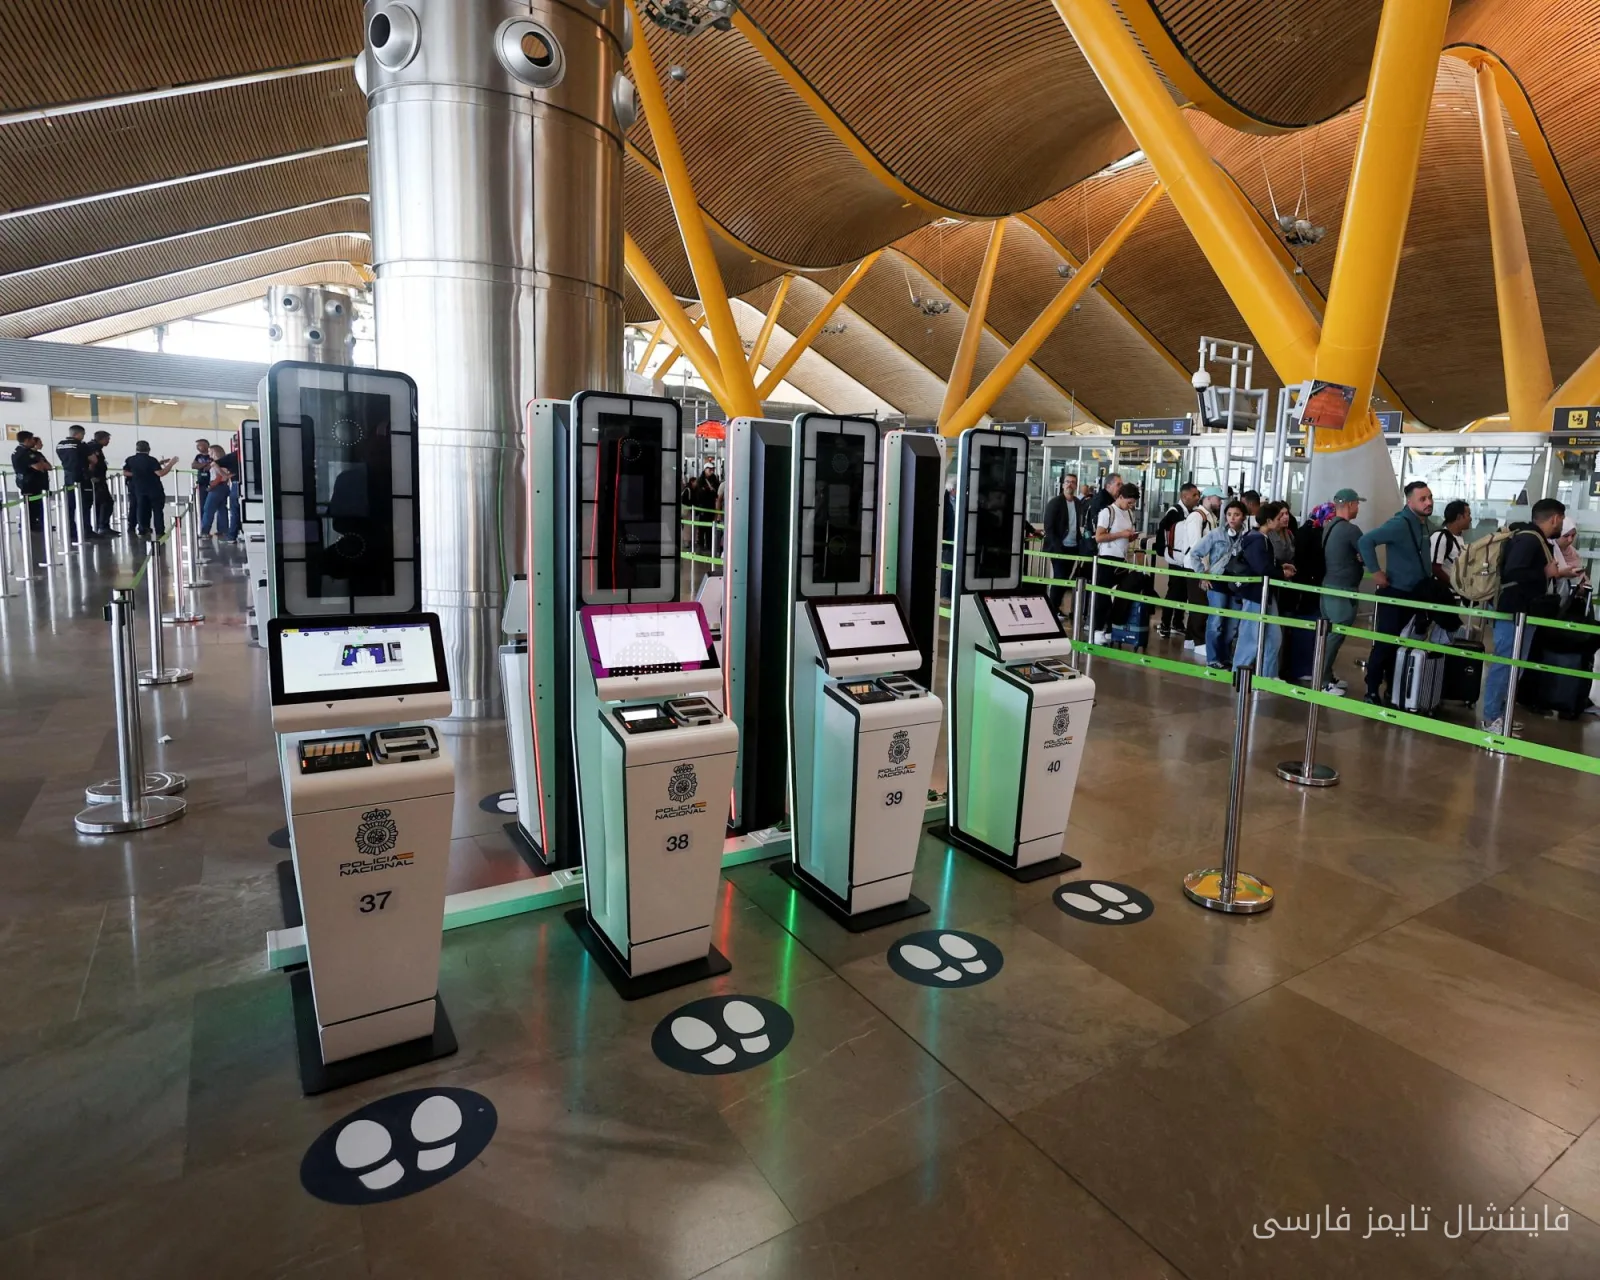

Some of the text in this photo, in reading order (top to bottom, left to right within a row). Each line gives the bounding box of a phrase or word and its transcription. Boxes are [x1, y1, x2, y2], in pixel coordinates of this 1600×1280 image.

[1156, 468, 1167, 478] 10
[878, 766, 907, 774] POLICIA
[1048, 760, 1060, 773] 40
[877, 770, 915, 779] NACIONAL
[885, 790, 903, 806] 39
[654, 808, 706, 820] NACIONAL
[656, 803, 696, 814] POLICIA
[666, 833, 689, 852] 38
[339, 854, 399, 871] POLICIA
[339, 860, 414, 877] NACIONAL
[359, 890, 393, 913] 37
